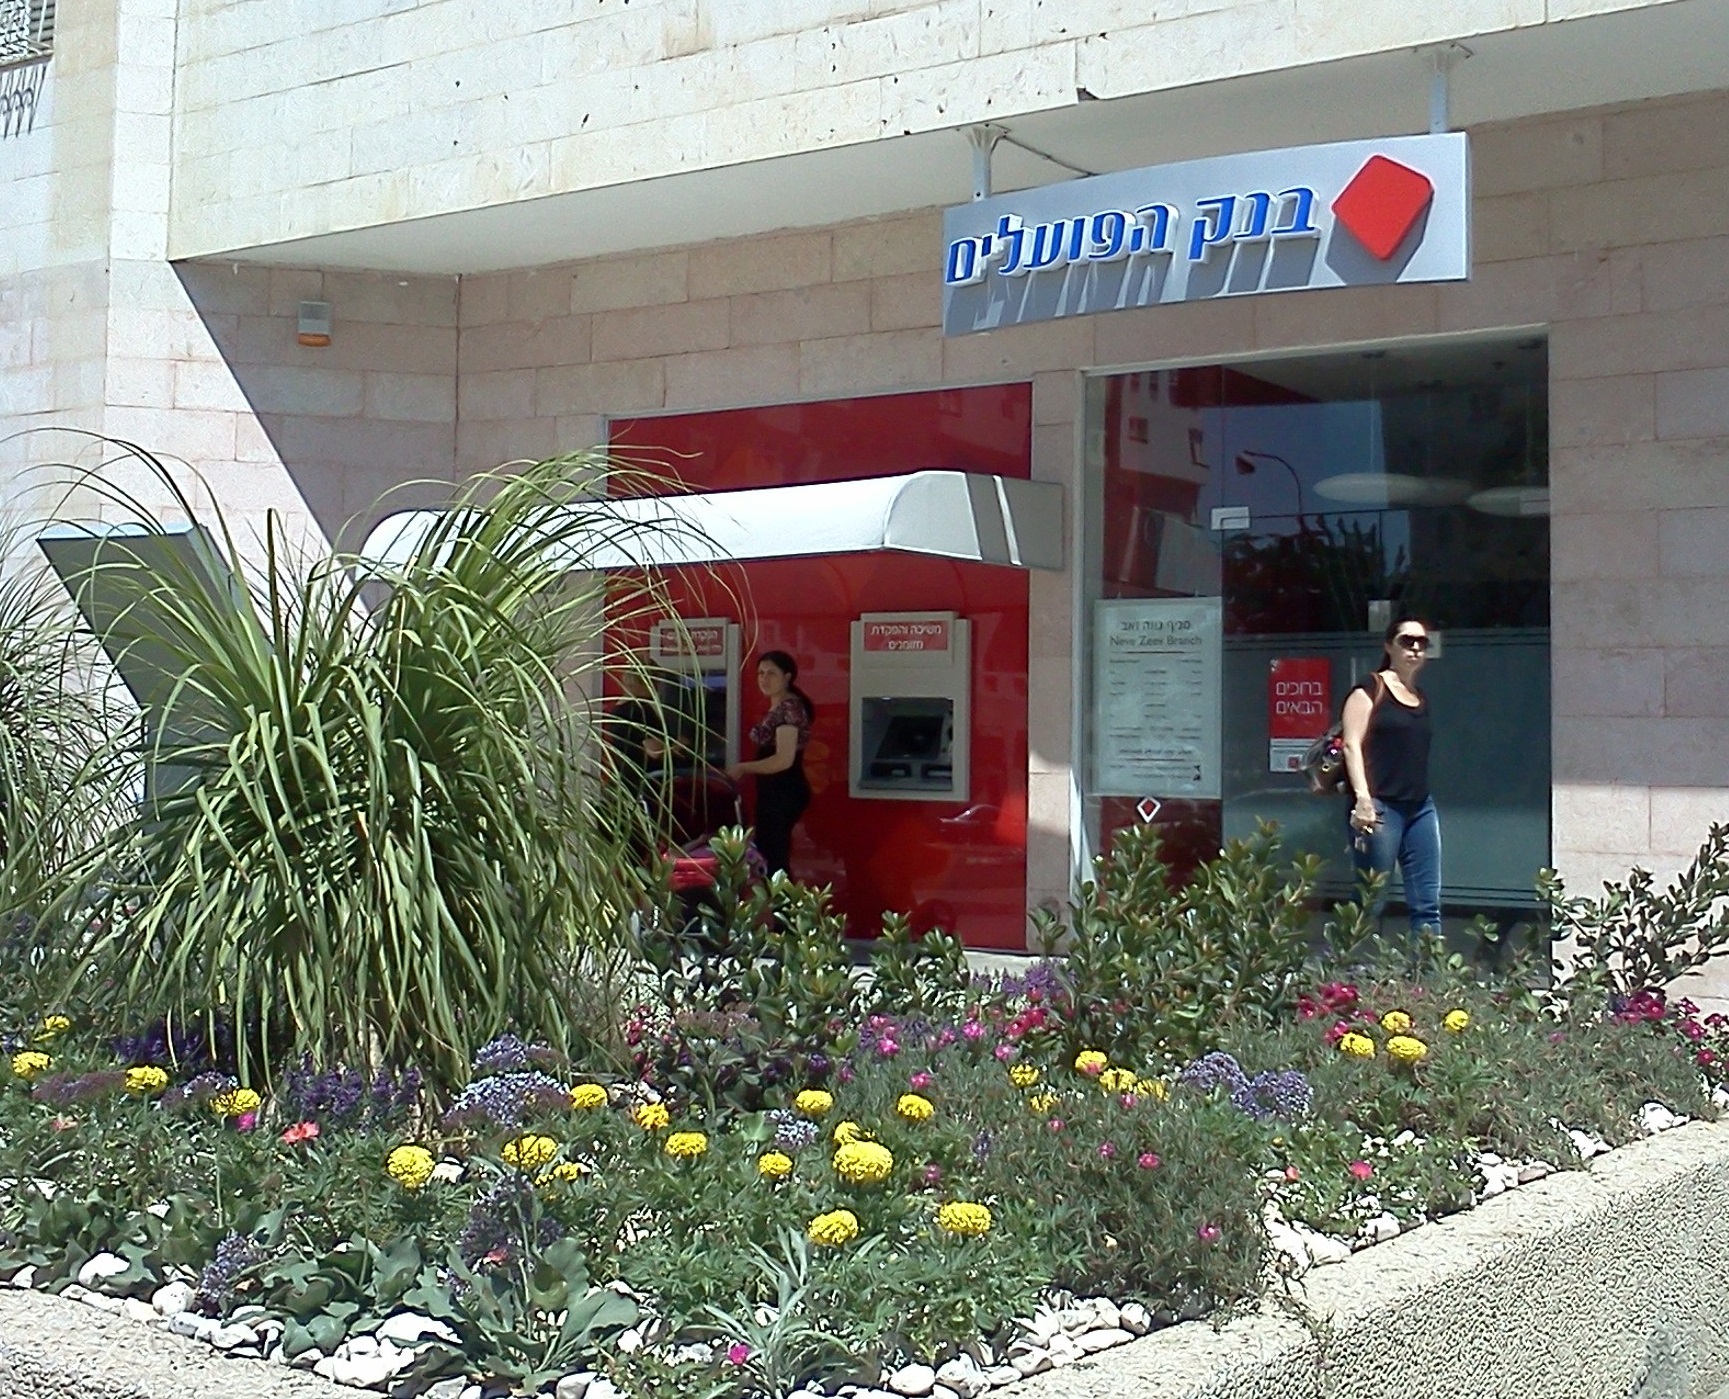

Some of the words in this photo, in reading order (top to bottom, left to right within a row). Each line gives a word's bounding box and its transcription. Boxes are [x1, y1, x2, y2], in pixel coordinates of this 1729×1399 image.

[1188, 185, 1319, 264] בנק
[945, 202, 1179, 286] הפועלים
[871, 625, 908, 636] והפקדת
[910, 624, 942, 635] משיכה
[1167, 620, 1191, 632] סניף
[888, 640, 924, 650] מזומנים
[1166, 635, 1202, 646] Branch
[1276, 681, 1323, 696] ברוכים
[1276, 700, 1323, 715] הבאים
